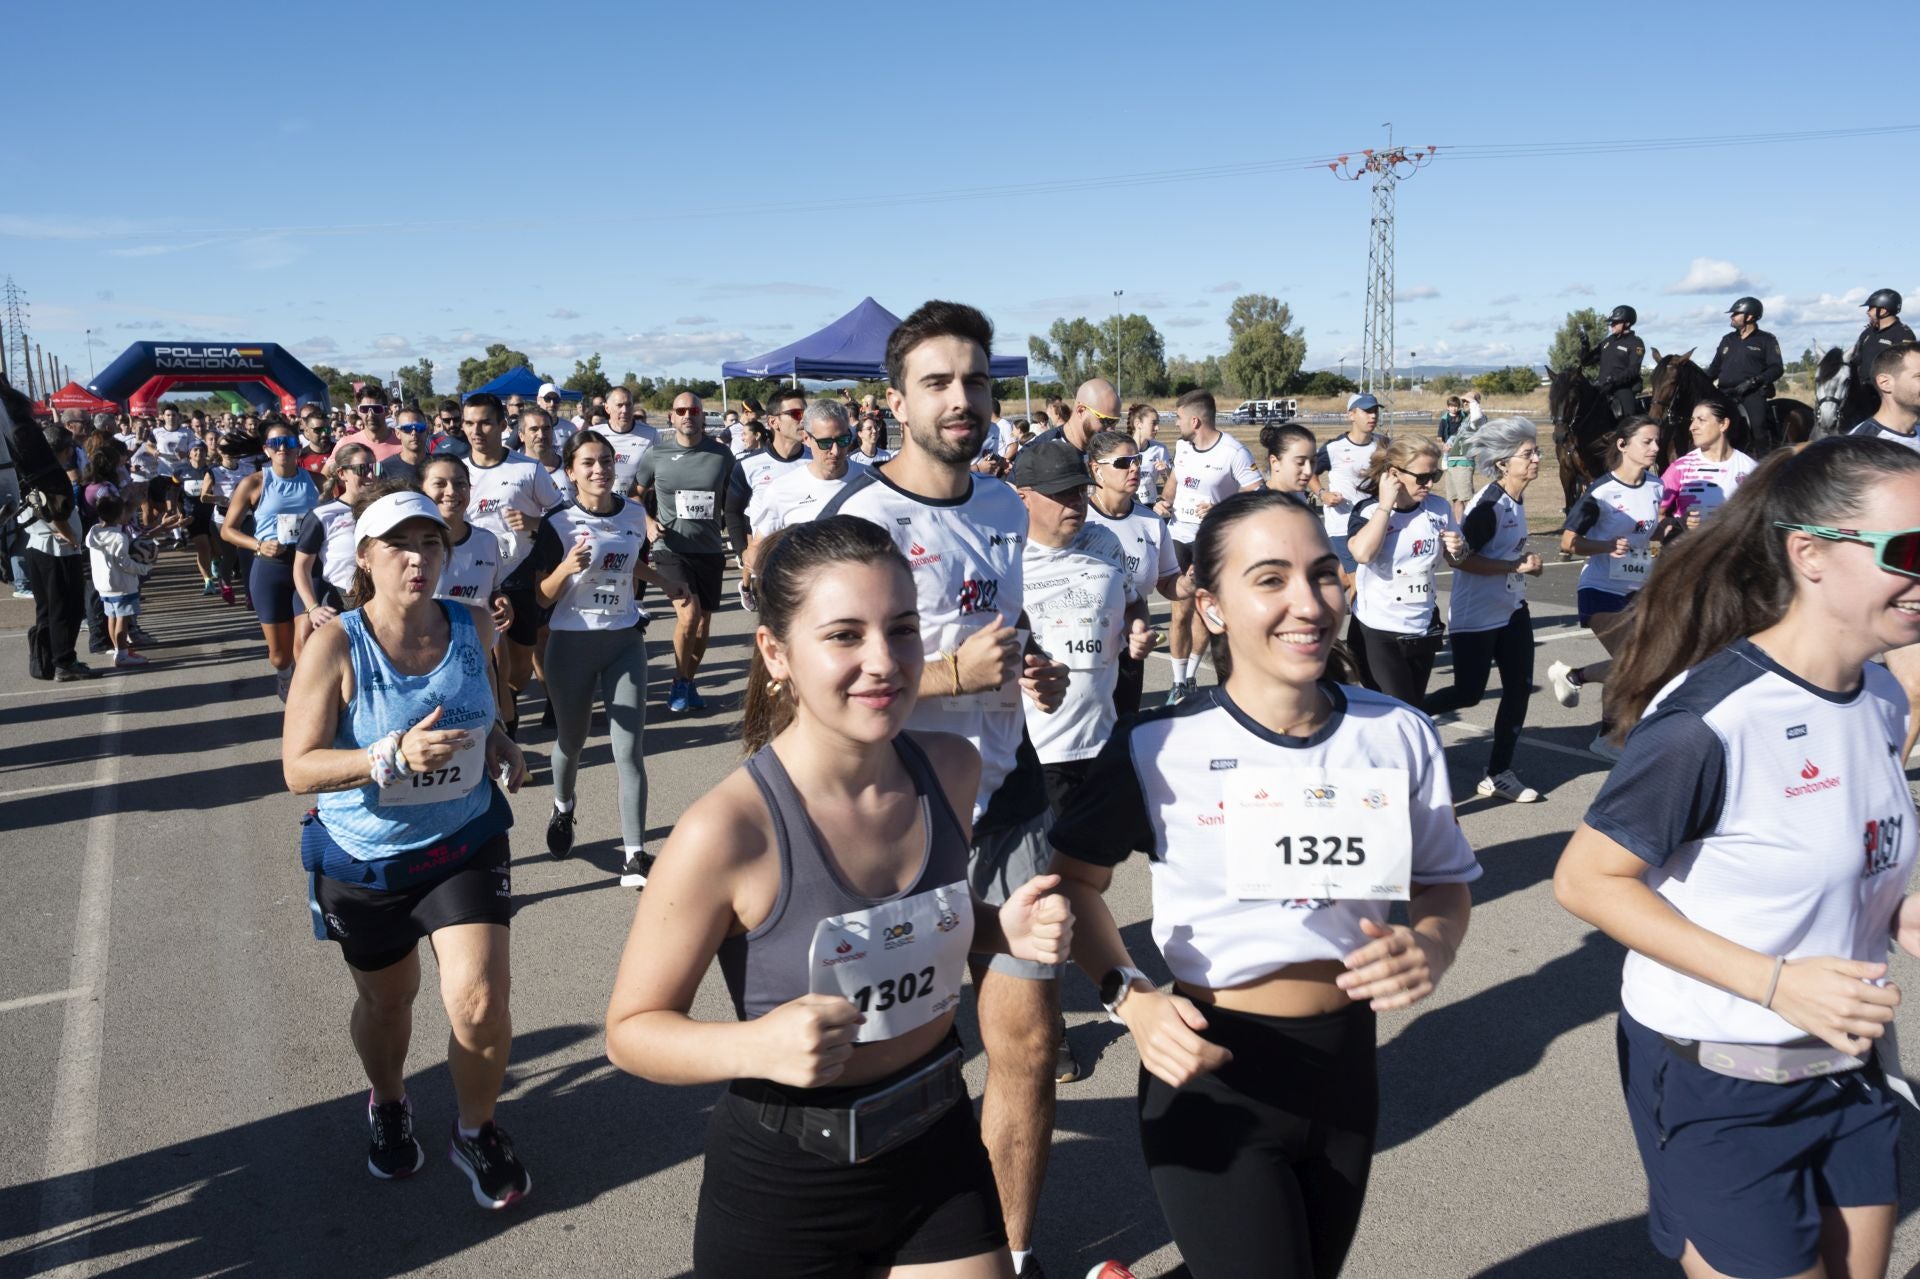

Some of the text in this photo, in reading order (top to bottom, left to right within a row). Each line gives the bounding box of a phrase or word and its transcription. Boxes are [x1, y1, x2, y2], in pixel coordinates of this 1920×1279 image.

[154, 347, 241, 357] POLICIA
[156, 358, 265, 369] NACIONAL
[686, 505, 705, 513] 1495
[1181, 508, 1195, 516] 140
[1622, 564, 1645, 574] 1044
[593, 593, 620, 605] 1175
[1065, 639, 1102, 654] 1460
[412, 766, 462, 789] 1572
[1785, 776, 1841, 798] Santander
[1275, 835, 1366, 866] 1325
[854, 965, 936, 1013] 1302
